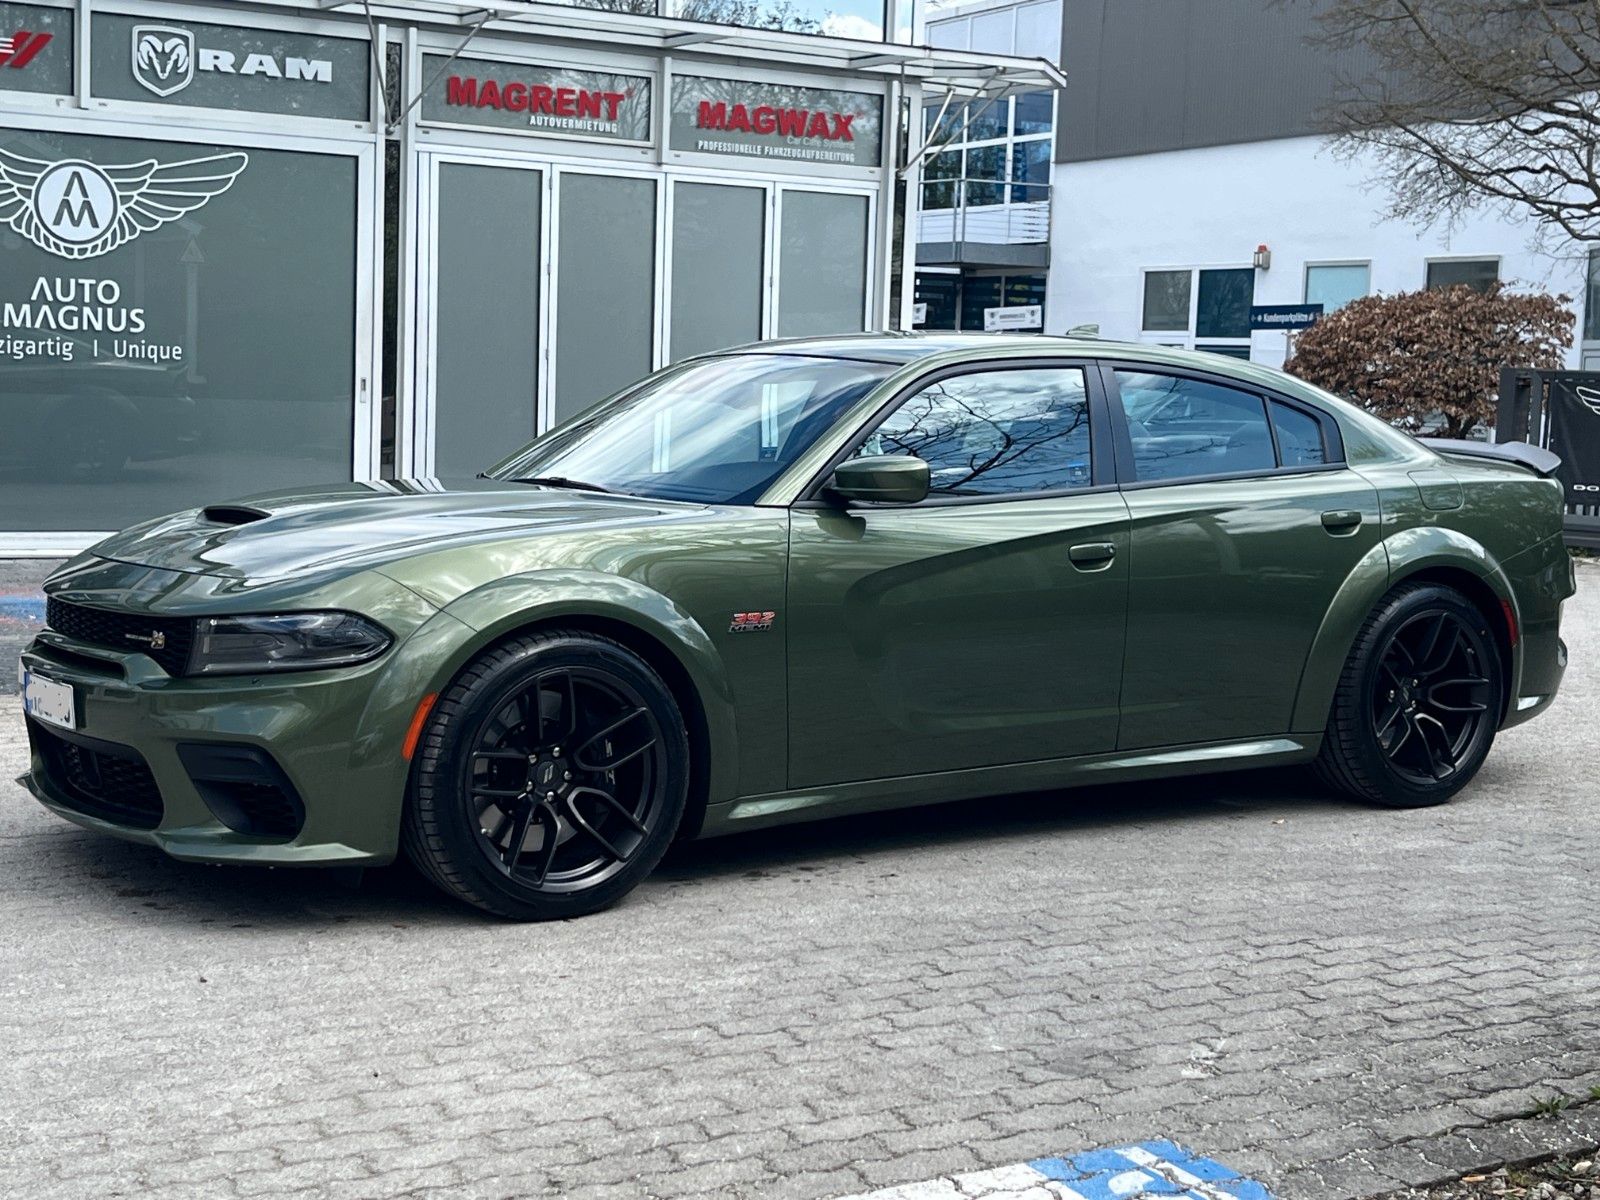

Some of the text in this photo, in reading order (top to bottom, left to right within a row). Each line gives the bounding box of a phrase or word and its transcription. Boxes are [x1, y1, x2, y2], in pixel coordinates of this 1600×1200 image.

[199, 48, 332, 82] RAM
[447, 76, 625, 121] MAGRENT
[529, 115, 617, 134] AUTOVERMIETUNG
[697, 101, 854, 141] MAGWAX
[698, 140, 855, 163] PROFESSIONELLE FAHRZEUGAUFBEREITUNG
[31, 276, 120, 305] AUTO
[3, 303, 145, 333] MAGNUS
[114, 340, 182, 363] Unique
